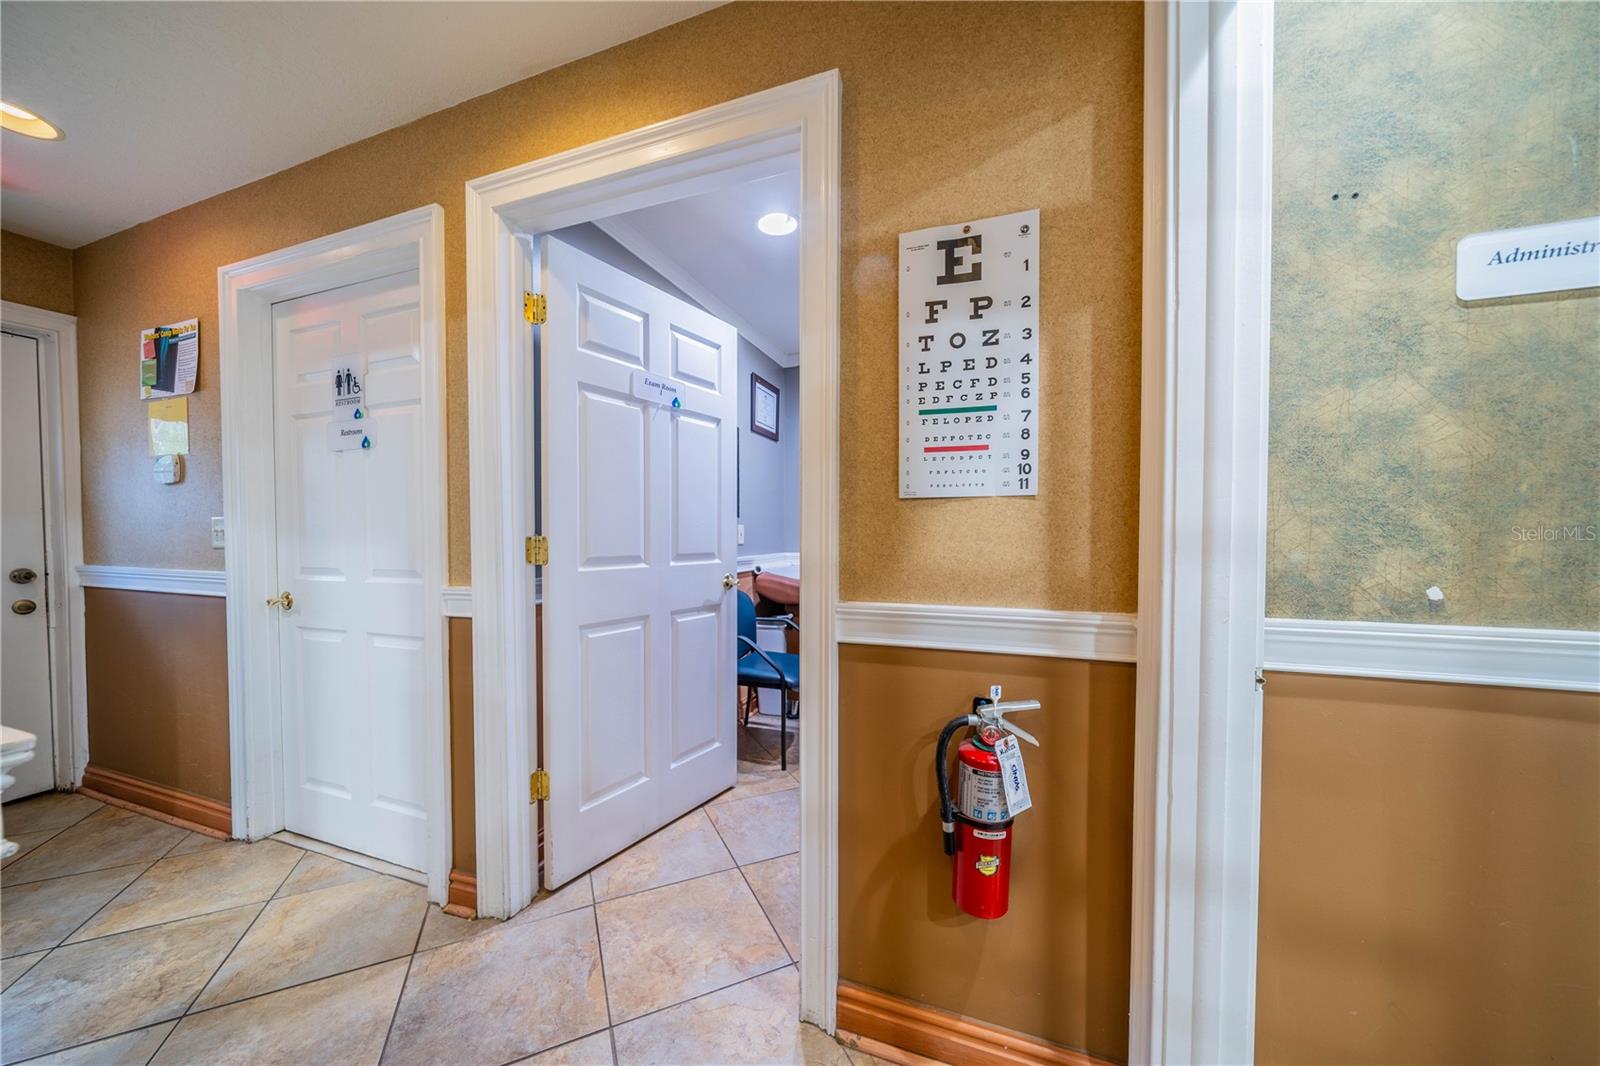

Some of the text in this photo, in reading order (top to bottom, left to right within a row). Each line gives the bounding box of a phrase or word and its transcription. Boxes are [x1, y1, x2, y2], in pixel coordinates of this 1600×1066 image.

[1487, 240, 1600, 266] Administr
[936, 234, 1030, 286] E 1
[1020, 295, 1032, 308] 2
[1021, 327, 1033, 340] 3
[1019, 353, 1033, 365] 4
[1020, 372, 1031, 385] 5
[644, 377, 678, 394] Exam Room
[1020, 387, 1031, 399] 6
[1020, 409, 1032, 422] 7
[1020, 428, 1031, 440] 8
[1020, 448, 1031, 461] 9
[1017, 463, 1032, 475] 10
[1018, 478, 1030, 490] 11
